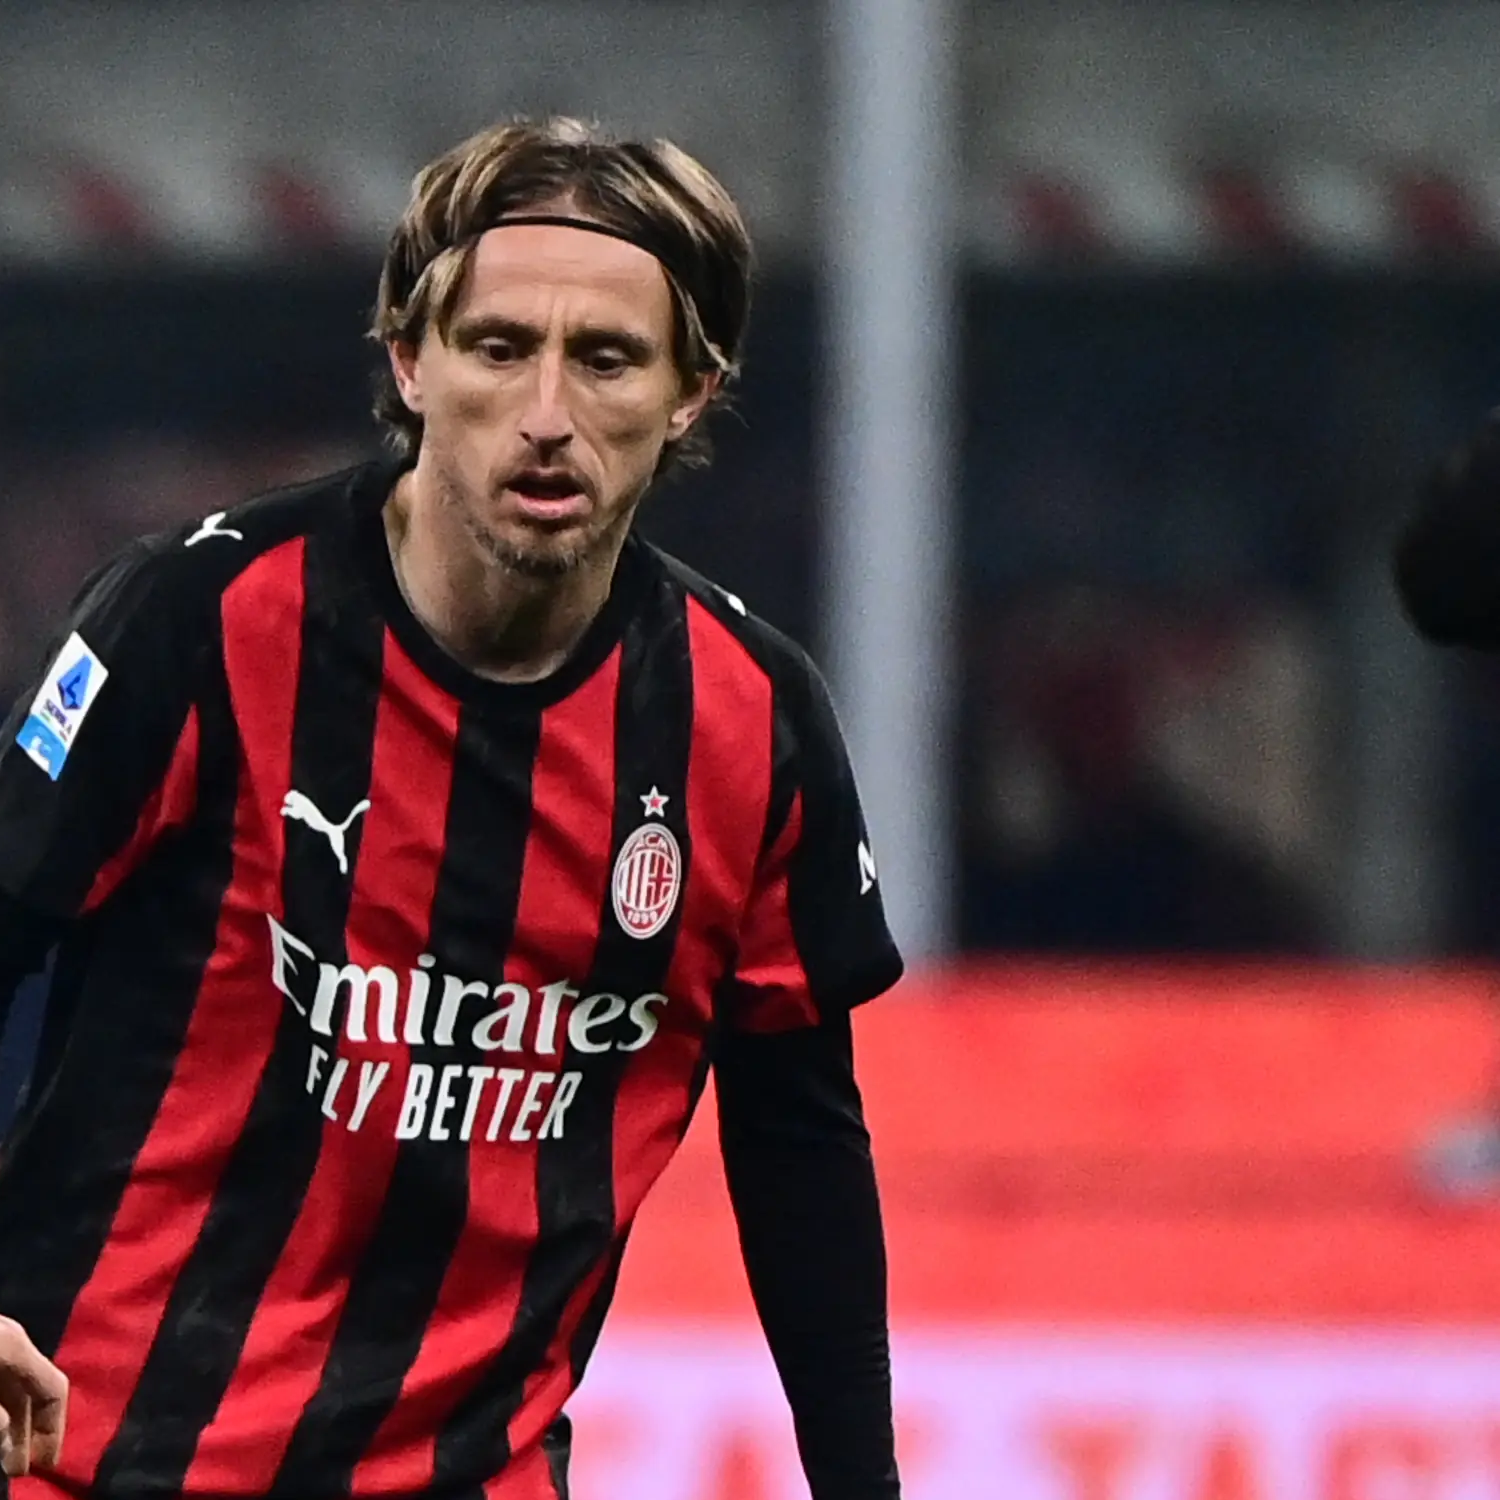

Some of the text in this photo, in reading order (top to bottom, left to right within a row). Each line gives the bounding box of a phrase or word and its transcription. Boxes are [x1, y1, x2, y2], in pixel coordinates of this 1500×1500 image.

[267, 912, 669, 1055] Emirates
[306, 1044, 584, 1143] FLY BETTER
